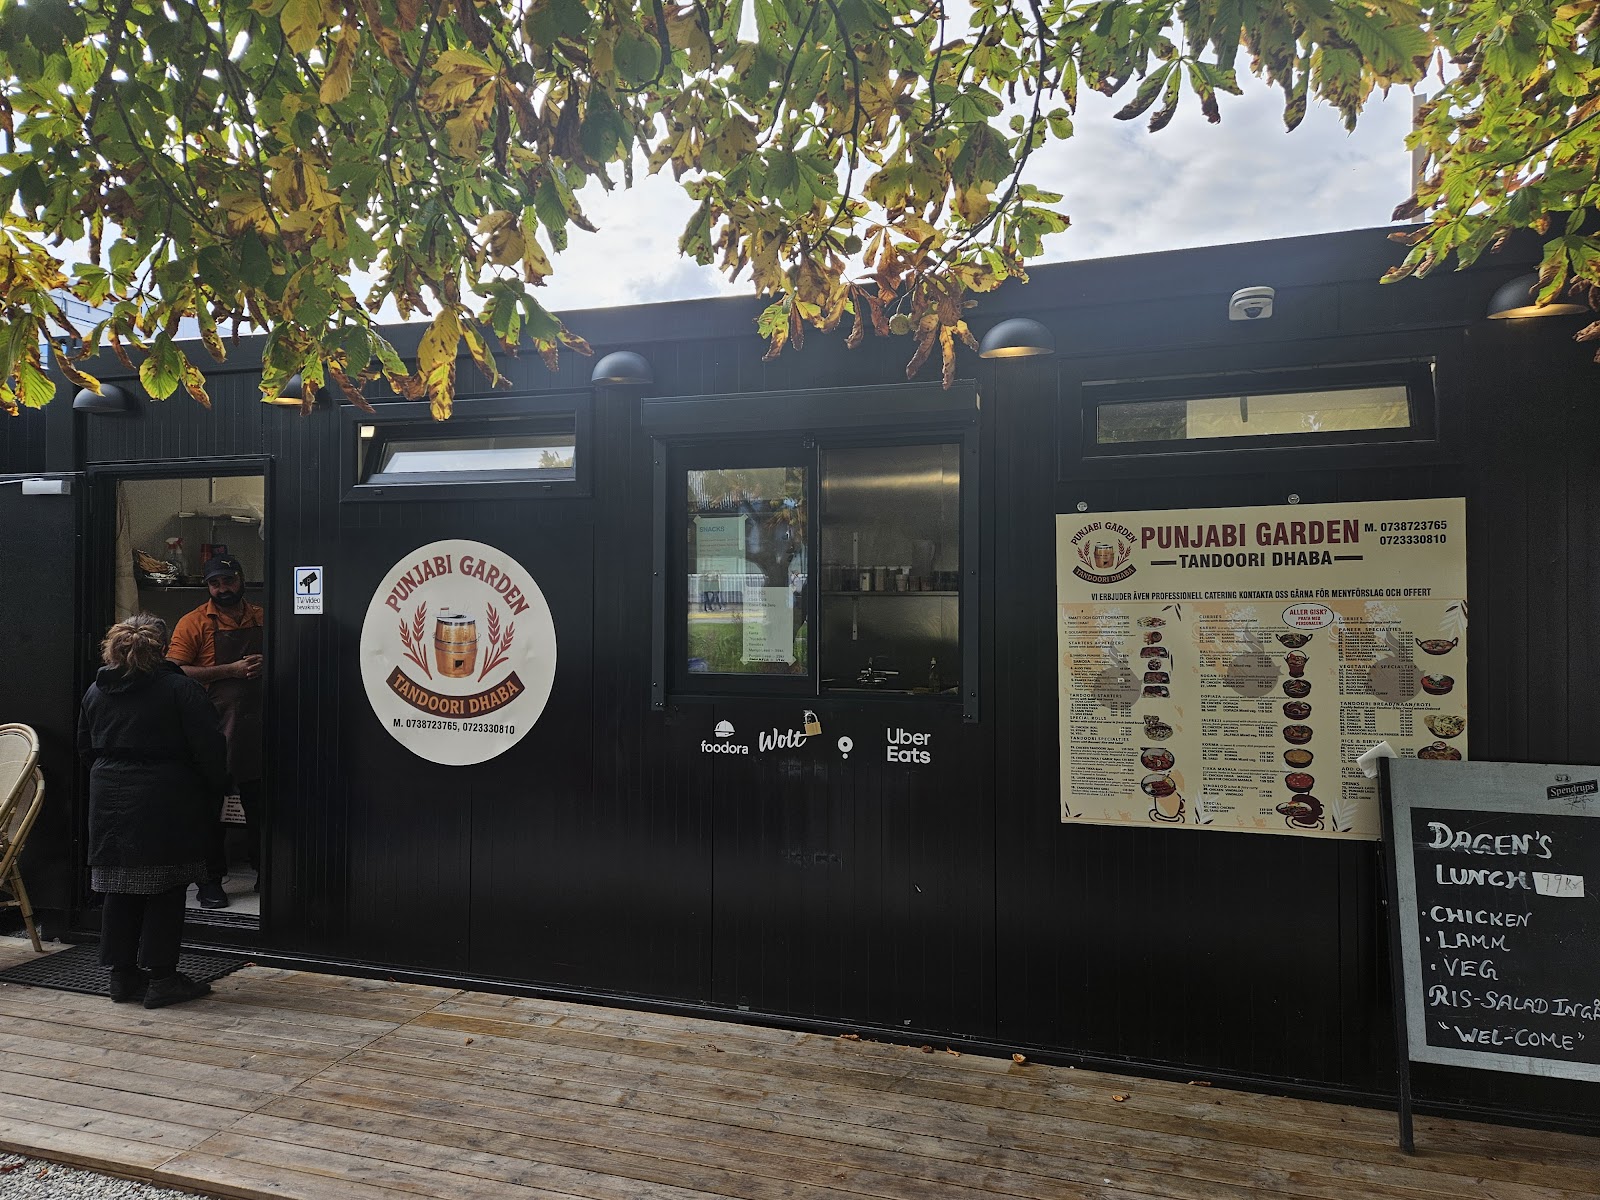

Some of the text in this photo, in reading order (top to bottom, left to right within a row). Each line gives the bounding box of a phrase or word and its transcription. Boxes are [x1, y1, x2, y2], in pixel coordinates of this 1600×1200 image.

[1070, 521, 1137, 546] PUNJABI GARDEN
[1142, 519, 1359, 549] PUNJABI GARDEN
[1364, 520, 1447, 532] M. 0738723765
[1380, 534, 1446, 545] 0723330810
[1179, 550, 1332, 568] TANDOORI DHABA
[1075, 568, 1134, 582] TANDOORI DHABA
[385, 555, 530, 616] PUNJABI GARDEN
[1091, 593, 1098, 601] VI
[1100, 592, 1132, 601] ERBJUDER
[1152, 592, 1202, 600] PROFESSIONELL
[1204, 591, 1237, 600] CATERING
[1239, 590, 1273, 599] KONTAKTA
[1274, 590, 1288, 598] OSS
[1386, 588, 1401, 596] OCH
[1404, 588, 1432, 596] OFFERT
[394, 674, 520, 714] TANDOORI DHABA
[393, 718, 515, 734] M. 0738723765, 0723330810
[759, 728, 807, 752] Wolt
[887, 728, 931, 746] Uber
[700, 740, 748, 754] foodora
[887, 746, 931, 764] Eats
[1550, 782, 1596, 797] Spendrups
[1427, 822, 1552, 860] DAGEN'S
[1436, 864, 1532, 890] LUNCH
[1430, 906, 1532, 927] CHICKEN
[1438, 930, 1511, 952] LAMM
[1444, 958, 1499, 980] VEG
